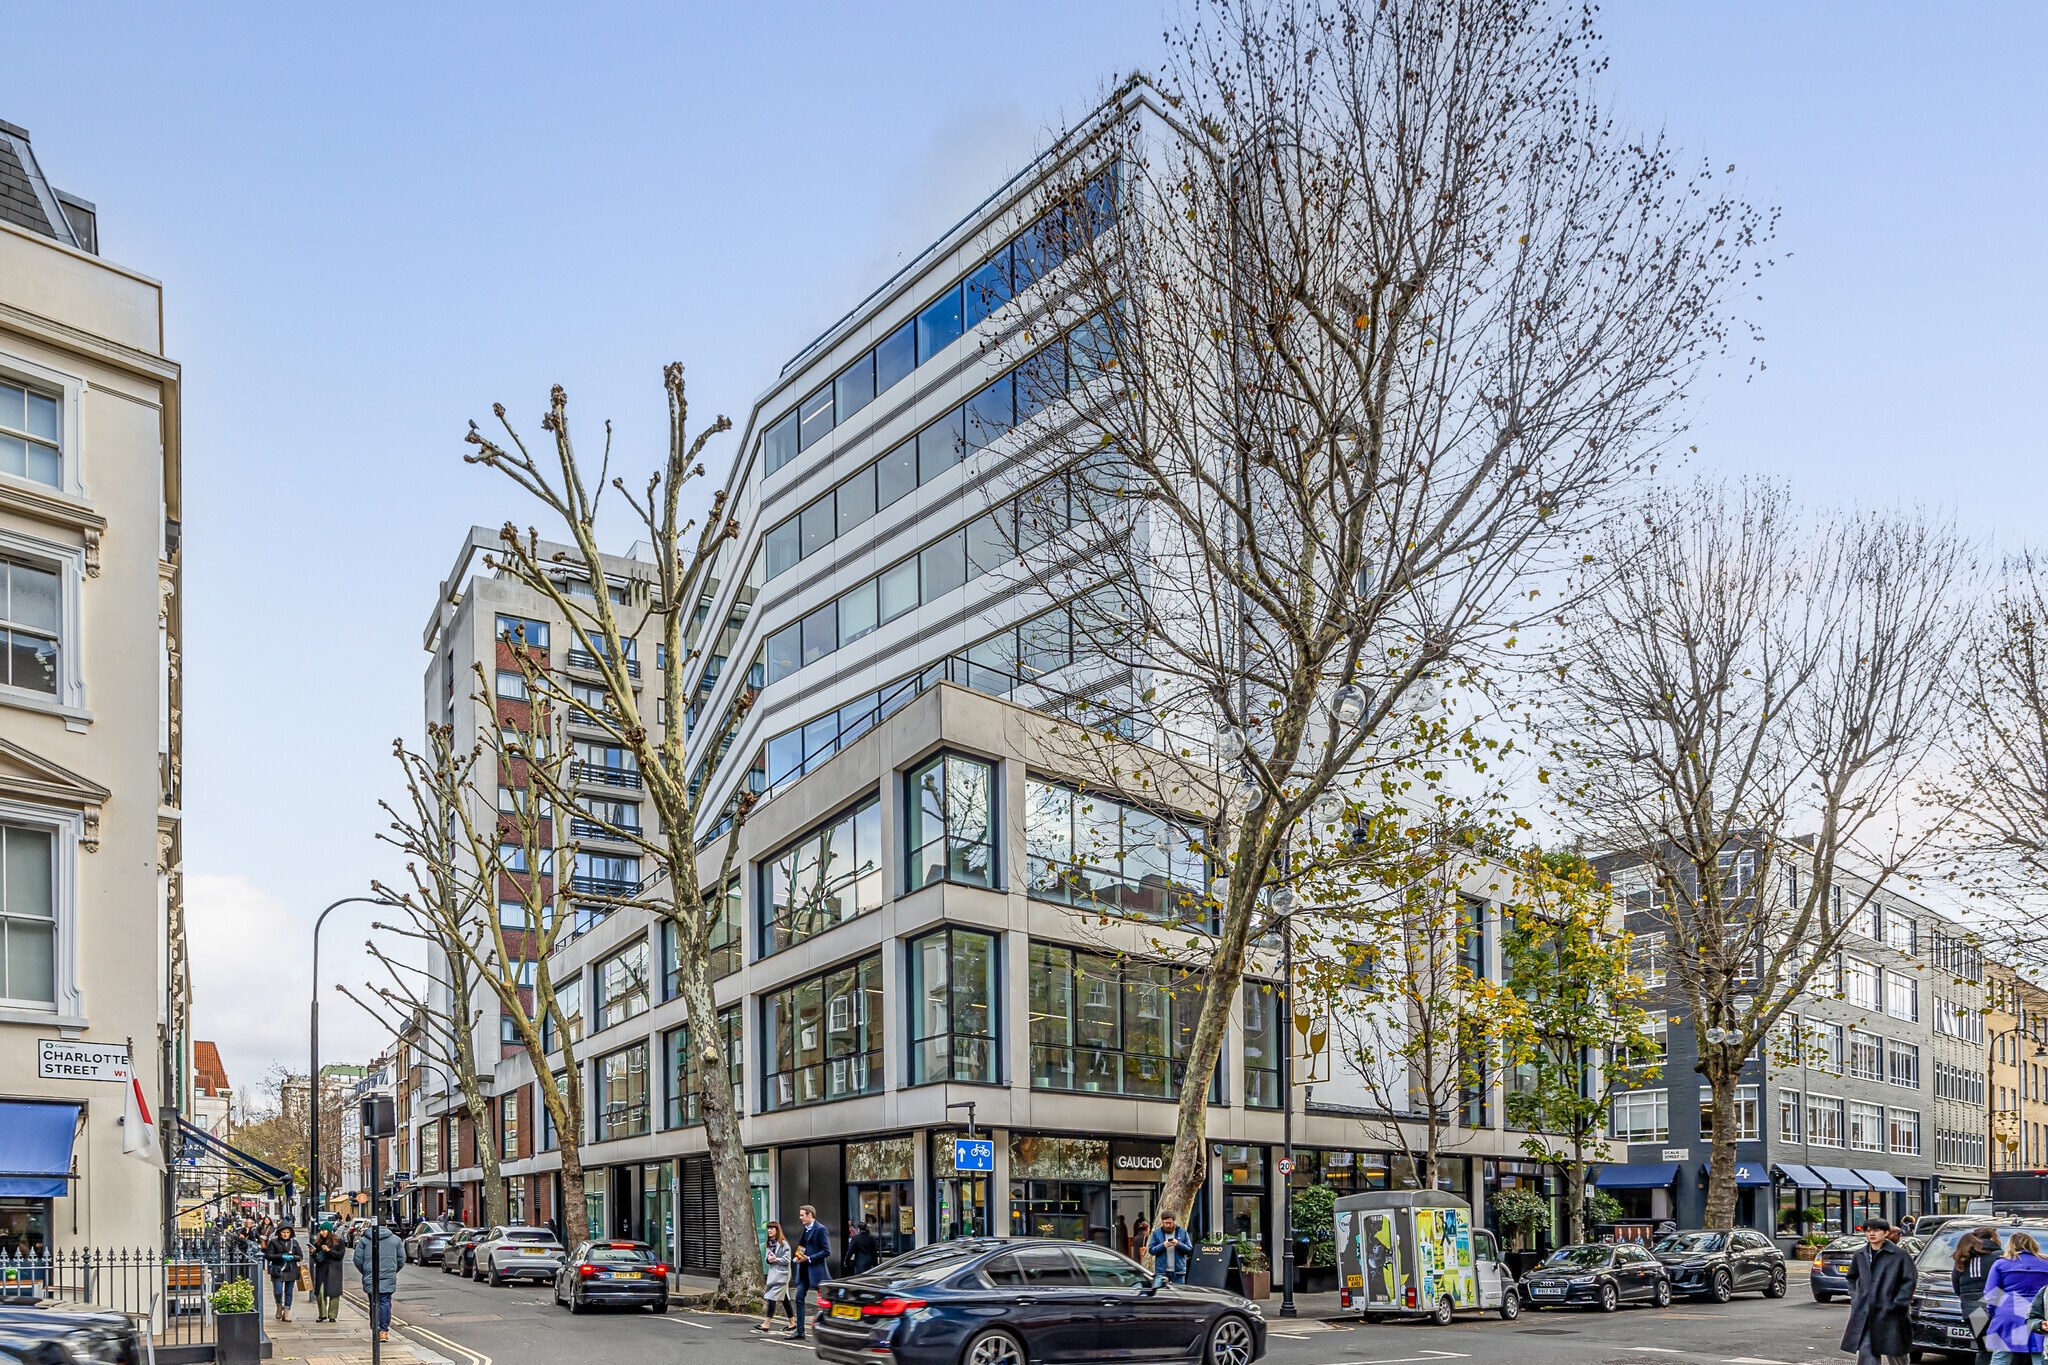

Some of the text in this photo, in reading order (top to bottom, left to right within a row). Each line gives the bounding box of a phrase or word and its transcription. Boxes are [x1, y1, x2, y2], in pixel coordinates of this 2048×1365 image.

[43, 1050, 128, 1065] CHARLOTTE
[45, 1063, 98, 1076] STREET
[1117, 1155, 1163, 1169] GAUCHO
[1280, 1162, 1290, 1170] 20
